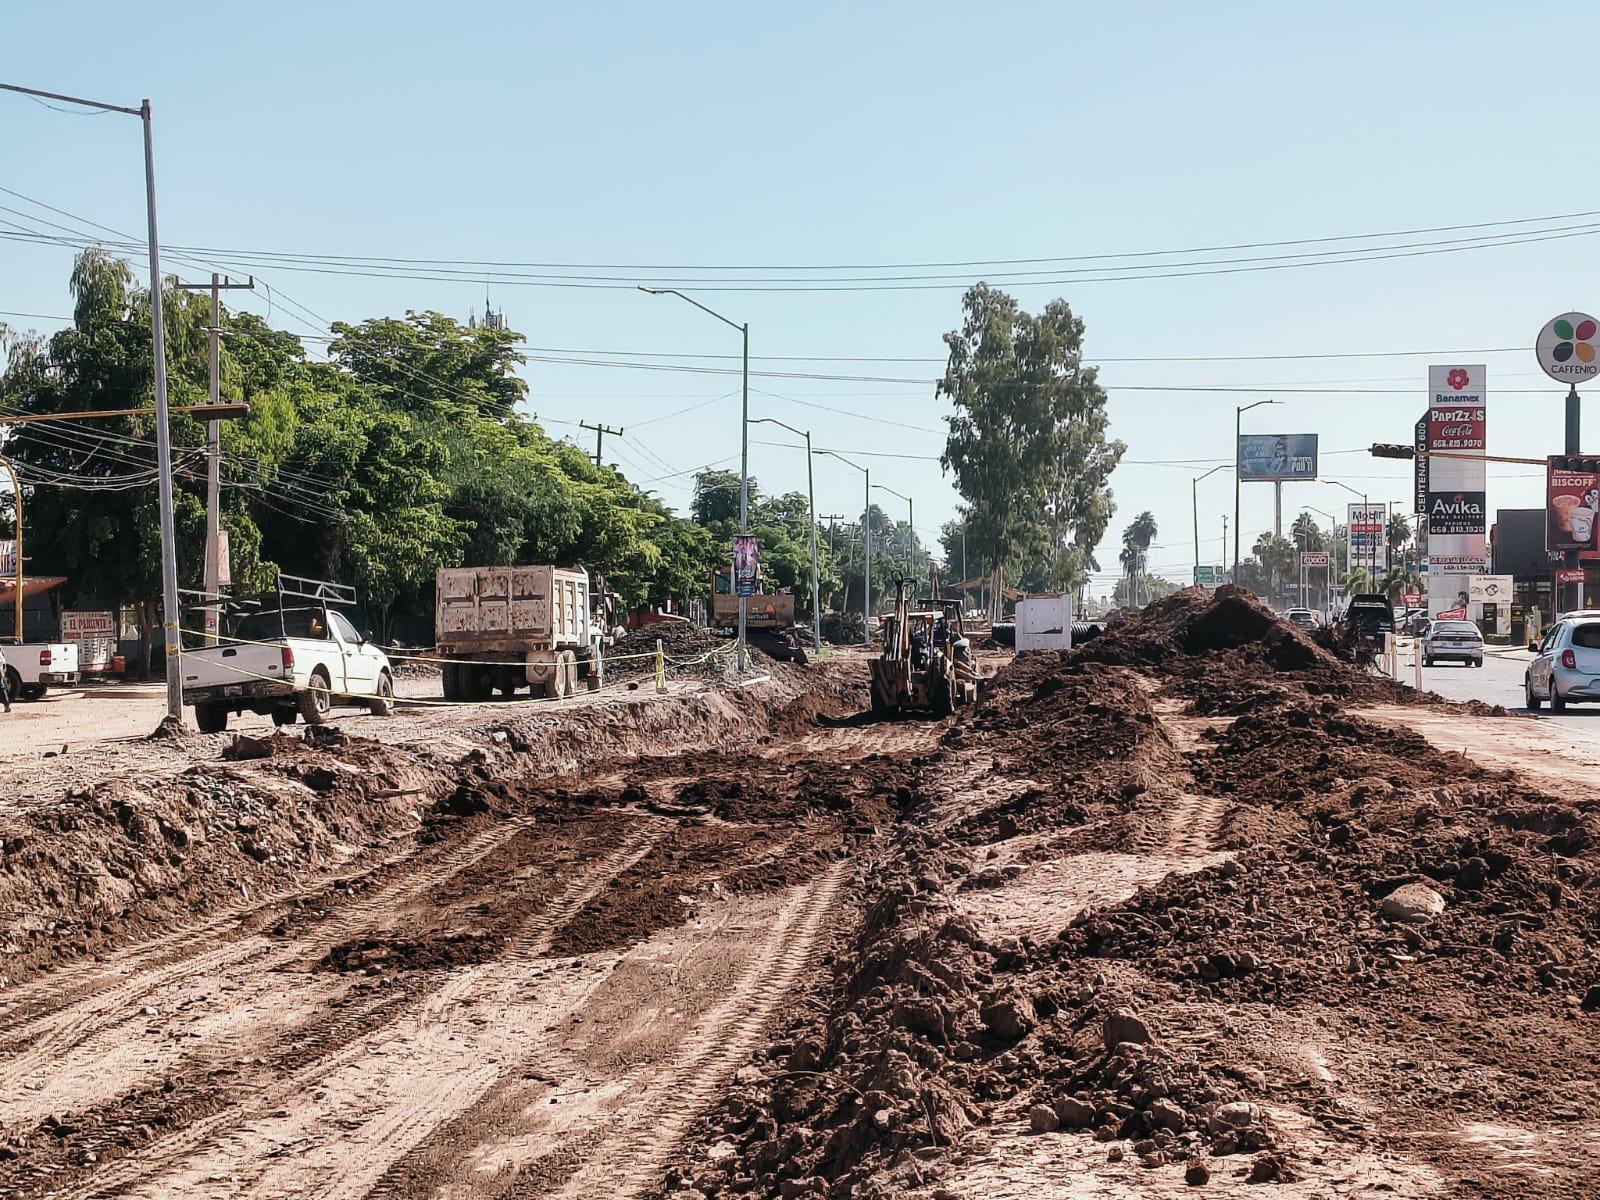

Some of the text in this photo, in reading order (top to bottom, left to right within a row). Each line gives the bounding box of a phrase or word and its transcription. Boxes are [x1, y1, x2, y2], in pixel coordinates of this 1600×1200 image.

[1551, 365, 1597, 374] CAFFENIO
[1436, 394, 1480, 403] Banamex
[1418, 422, 1426, 441] 600
[1551, 478, 1594, 487] BISCOFF
[1432, 498, 1482, 514] Avika
[1352, 511, 1381, 521] Mobil
